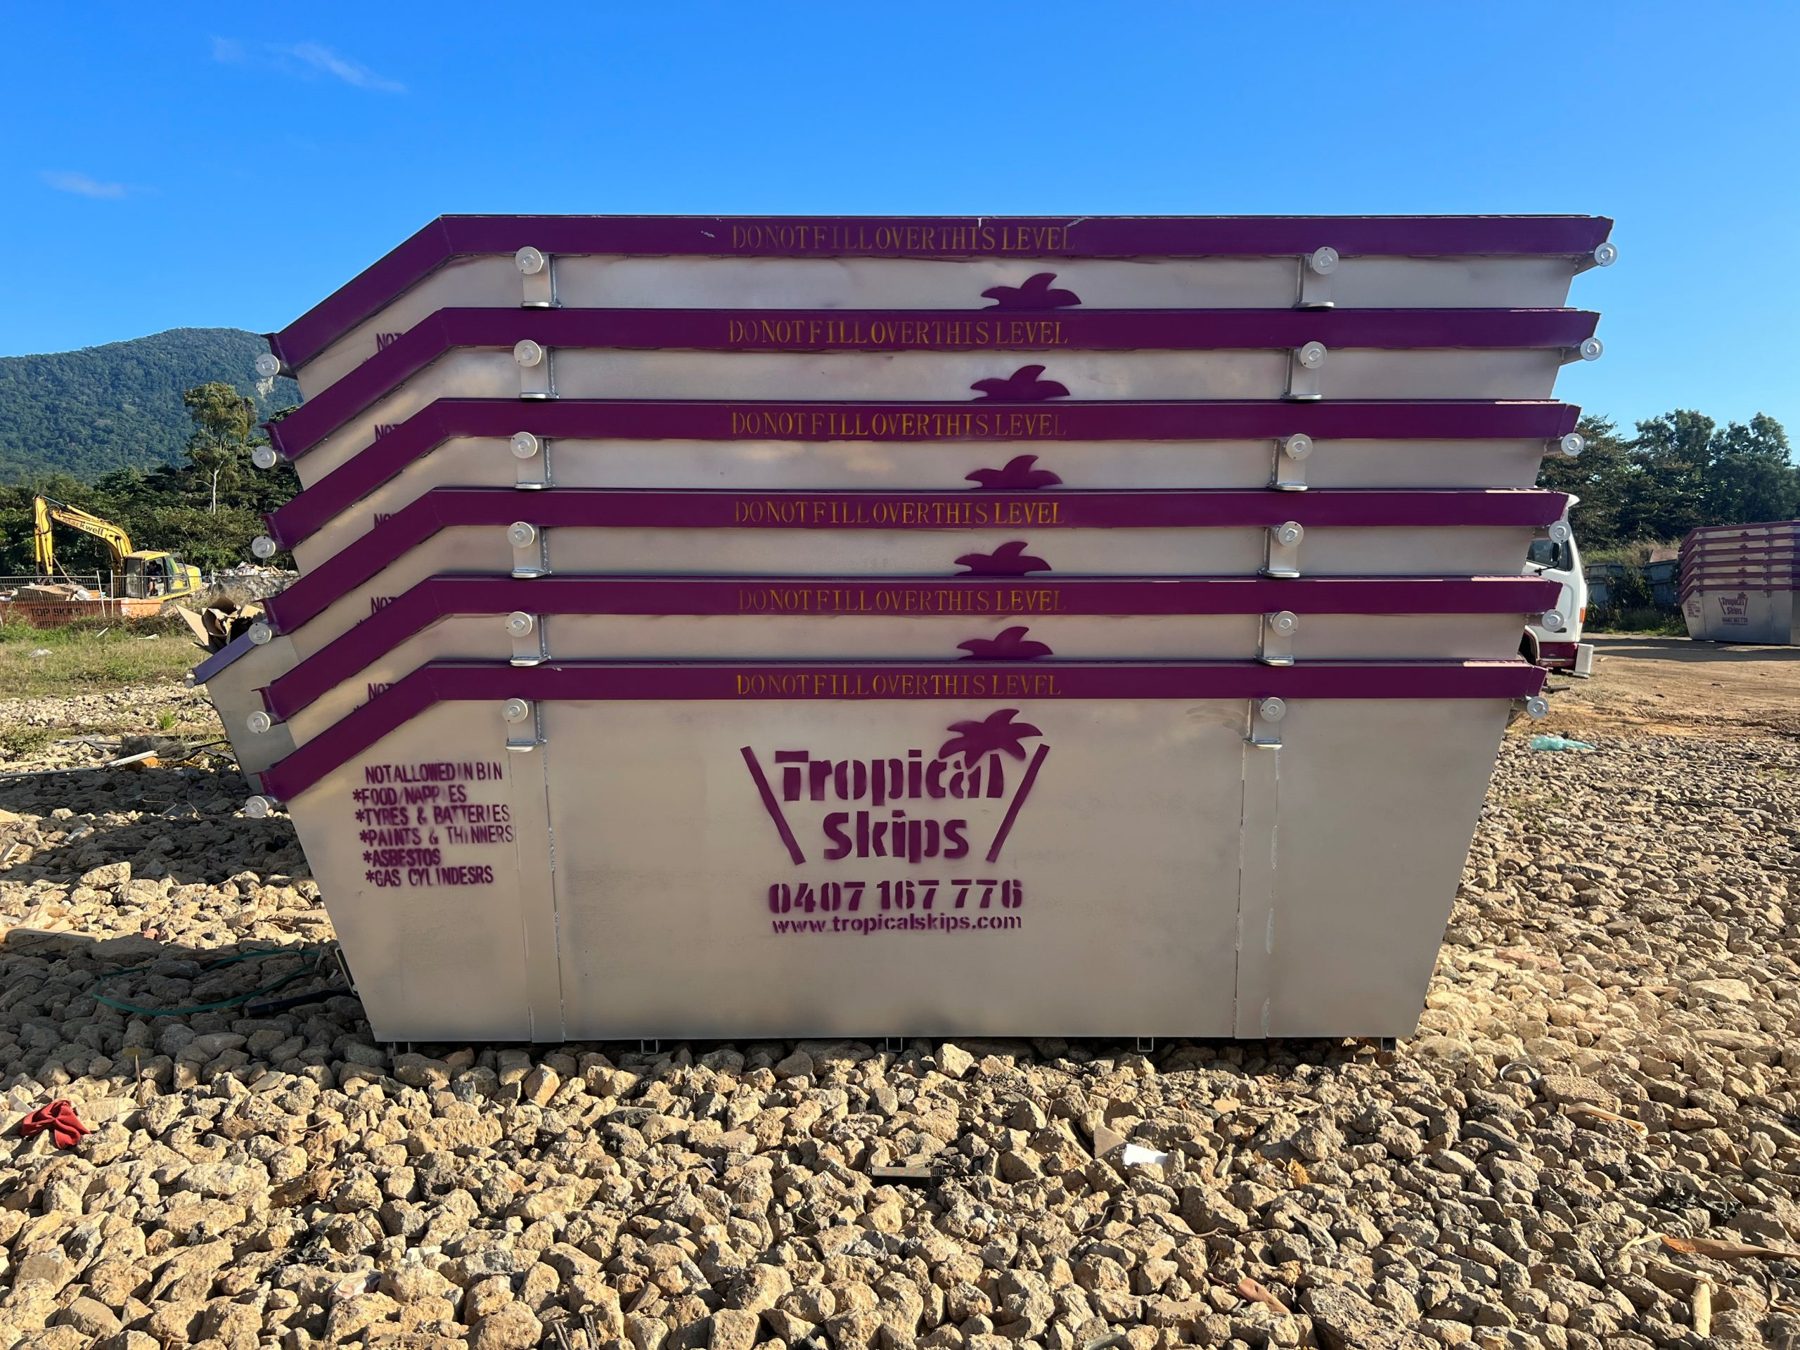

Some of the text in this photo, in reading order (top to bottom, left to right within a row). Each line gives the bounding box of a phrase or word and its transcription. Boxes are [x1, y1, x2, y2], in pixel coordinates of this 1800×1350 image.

[732, 225, 1075, 251] DO NOT FILL OVER THIS LEVEL
[730, 319, 1069, 345] DO NOT FILL OVER THIS LEVEL
[732, 412, 1066, 436] DO NOT FILL OVER THIS LEVEL
[735, 500, 1064, 525] DO NOT FILL OVER THIS LEVEL
[738, 589, 1067, 612] DO NOT FILL OVER THIS LEVEL
[736, 673, 1062, 696] DO NOT FILL OVER THIS LEVEL
[775, 749, 1004, 806] Tropical
[417, 806, 427, 825] &
[434, 804, 511, 825] BATTERIES
[823, 810, 969, 863] Skips
[768, 879, 1022, 914] 0407 167 776
[772, 912, 1022, 935] www.tropicalskips.com
